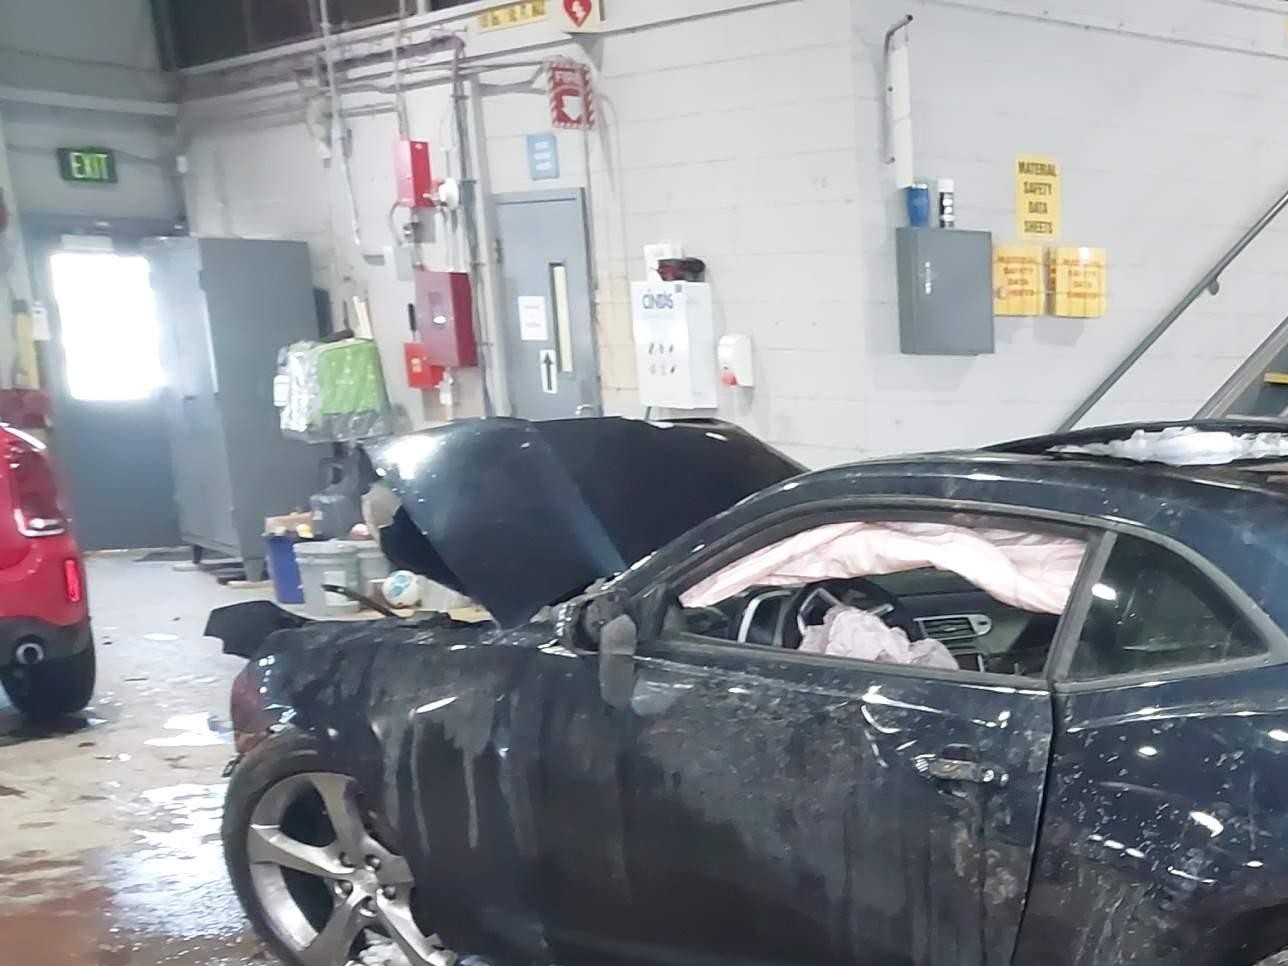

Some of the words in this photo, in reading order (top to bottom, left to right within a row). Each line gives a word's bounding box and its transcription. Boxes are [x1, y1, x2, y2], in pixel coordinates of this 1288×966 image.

[70, 151, 109, 179] EXIT
[1018, 160, 1056, 176] MATERIAL
[1024, 181, 1052, 195] SAFETY
[1028, 201, 1048, 214] DATA
[1023, 220, 1053, 234] SHEETS
